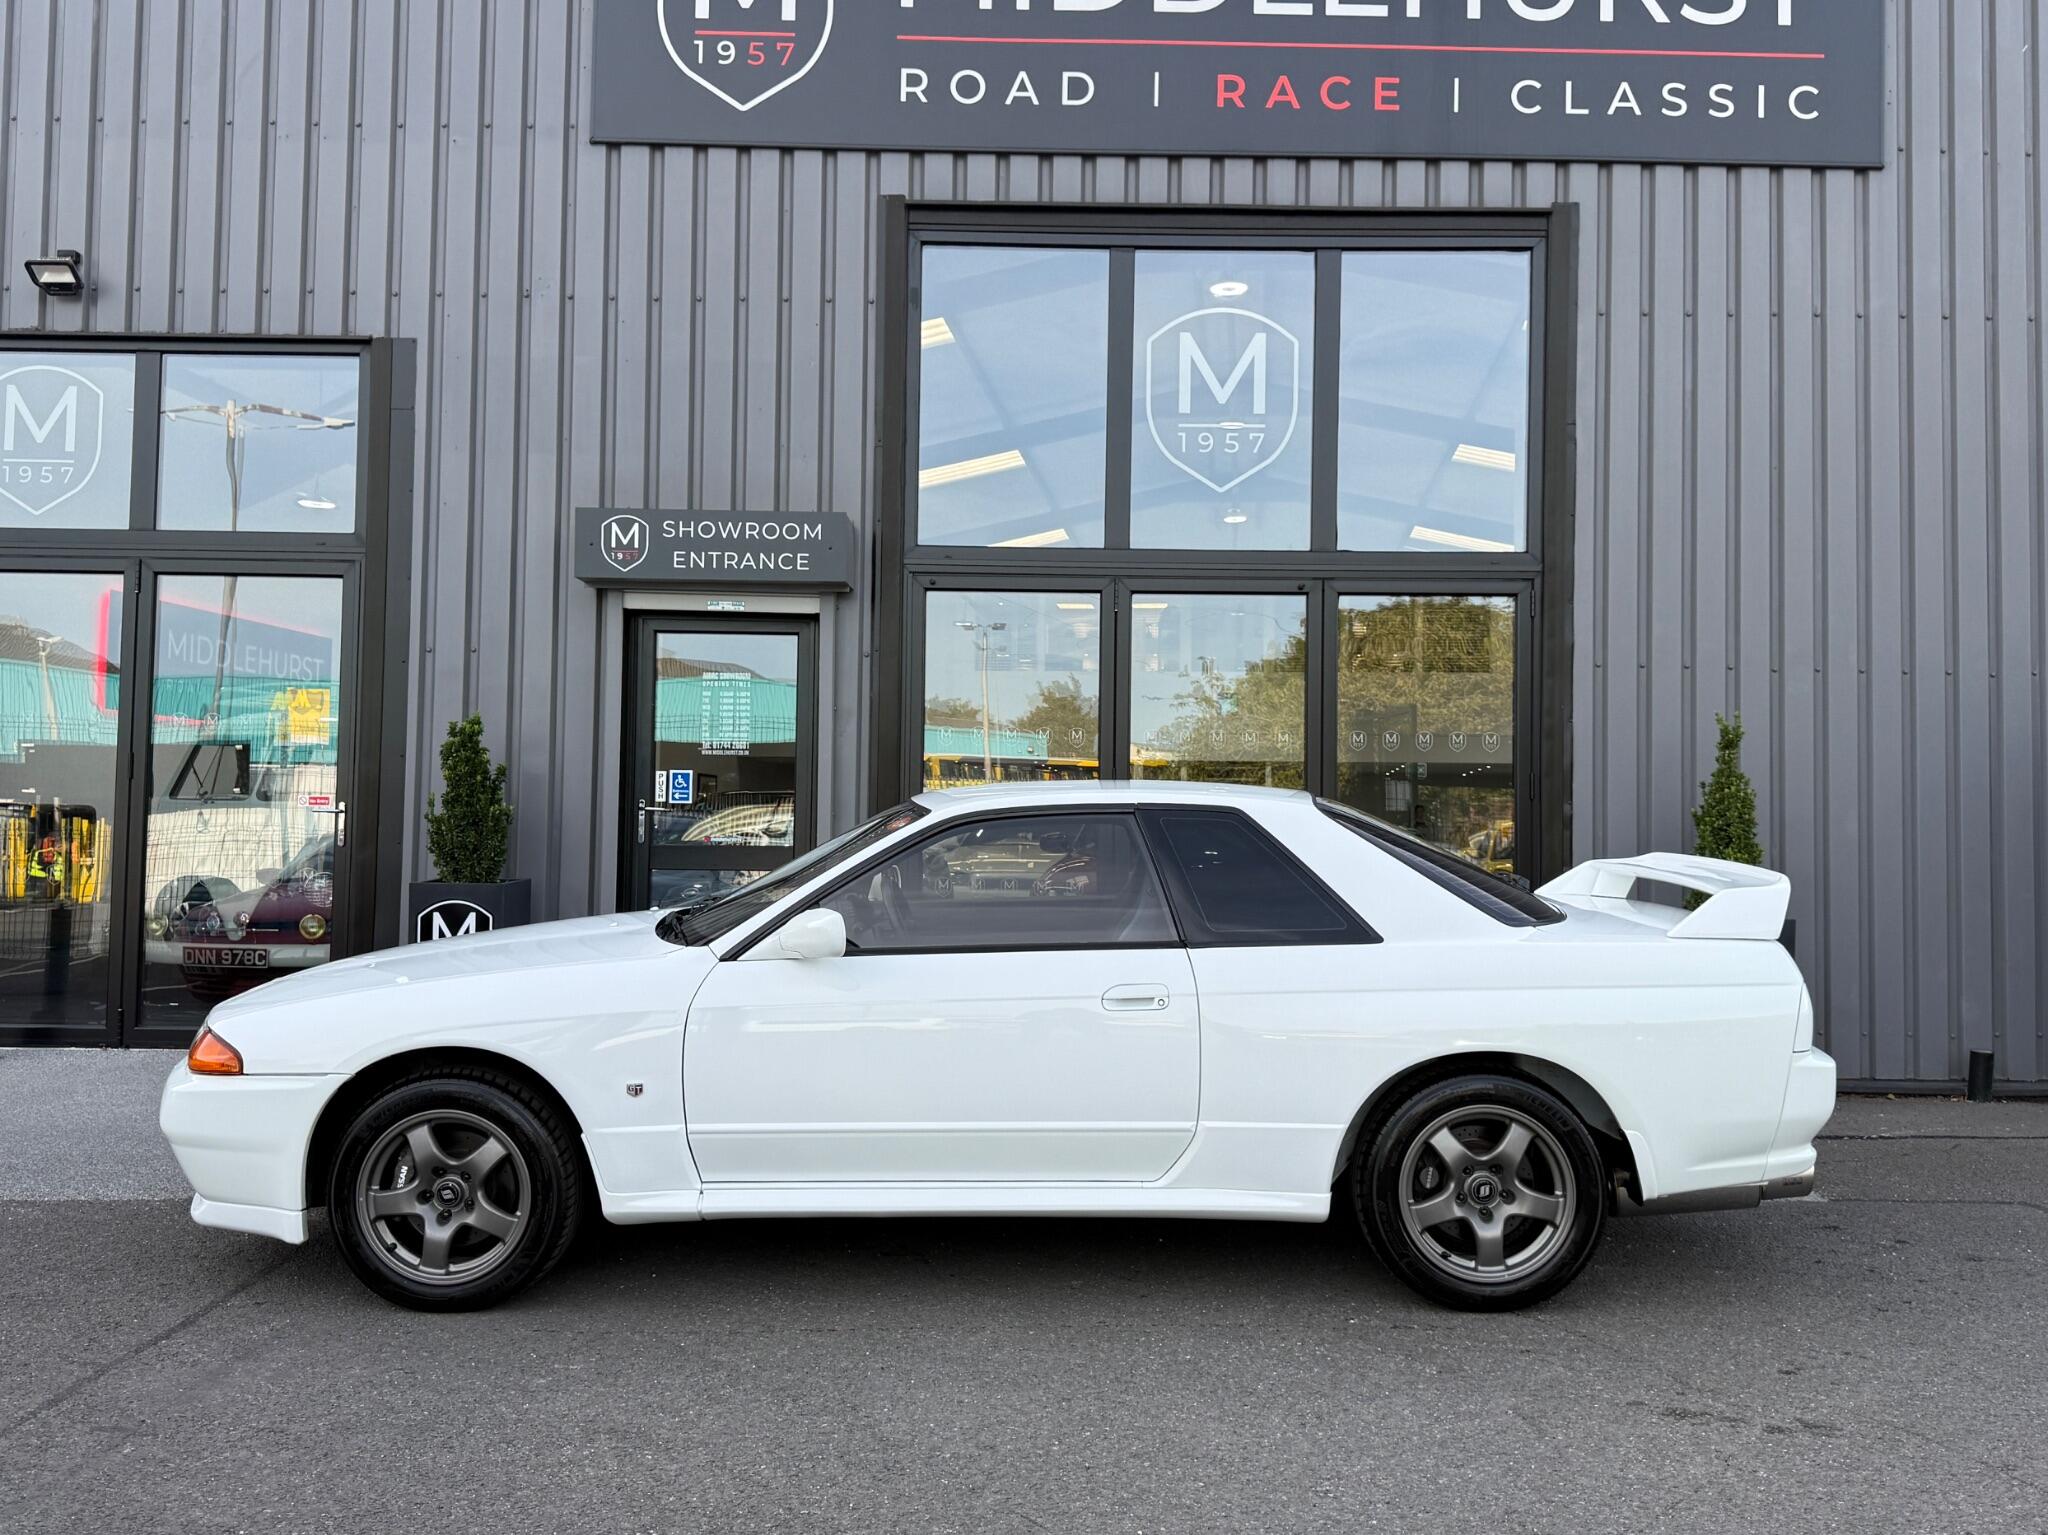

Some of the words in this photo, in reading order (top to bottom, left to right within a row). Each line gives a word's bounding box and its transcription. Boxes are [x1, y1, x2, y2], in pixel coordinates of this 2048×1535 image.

[694, 40, 795, 66] 1957
[900, 67, 1095, 106] ROAD
[1215, 73, 1400, 111] RACE
[1510, 79, 1820, 120] CLASSIC
[1178, 331, 1267, 414] M
[4, 384, 77, 452] M
[1177, 432, 1265, 453] 1957
[2, 465, 74, 484] 1957
[611, 521, 639, 548] M
[662, 520, 822, 541] SHOWROOM
[611, 552, 639, 560] 1957
[673, 551, 810, 571] ENTRANCE
[168, 628, 325, 682] MIDDLEHURST
[432, 911, 477, 940] M
[184, 948, 217, 965] DNN
[221, 949, 267, 966] 978C
